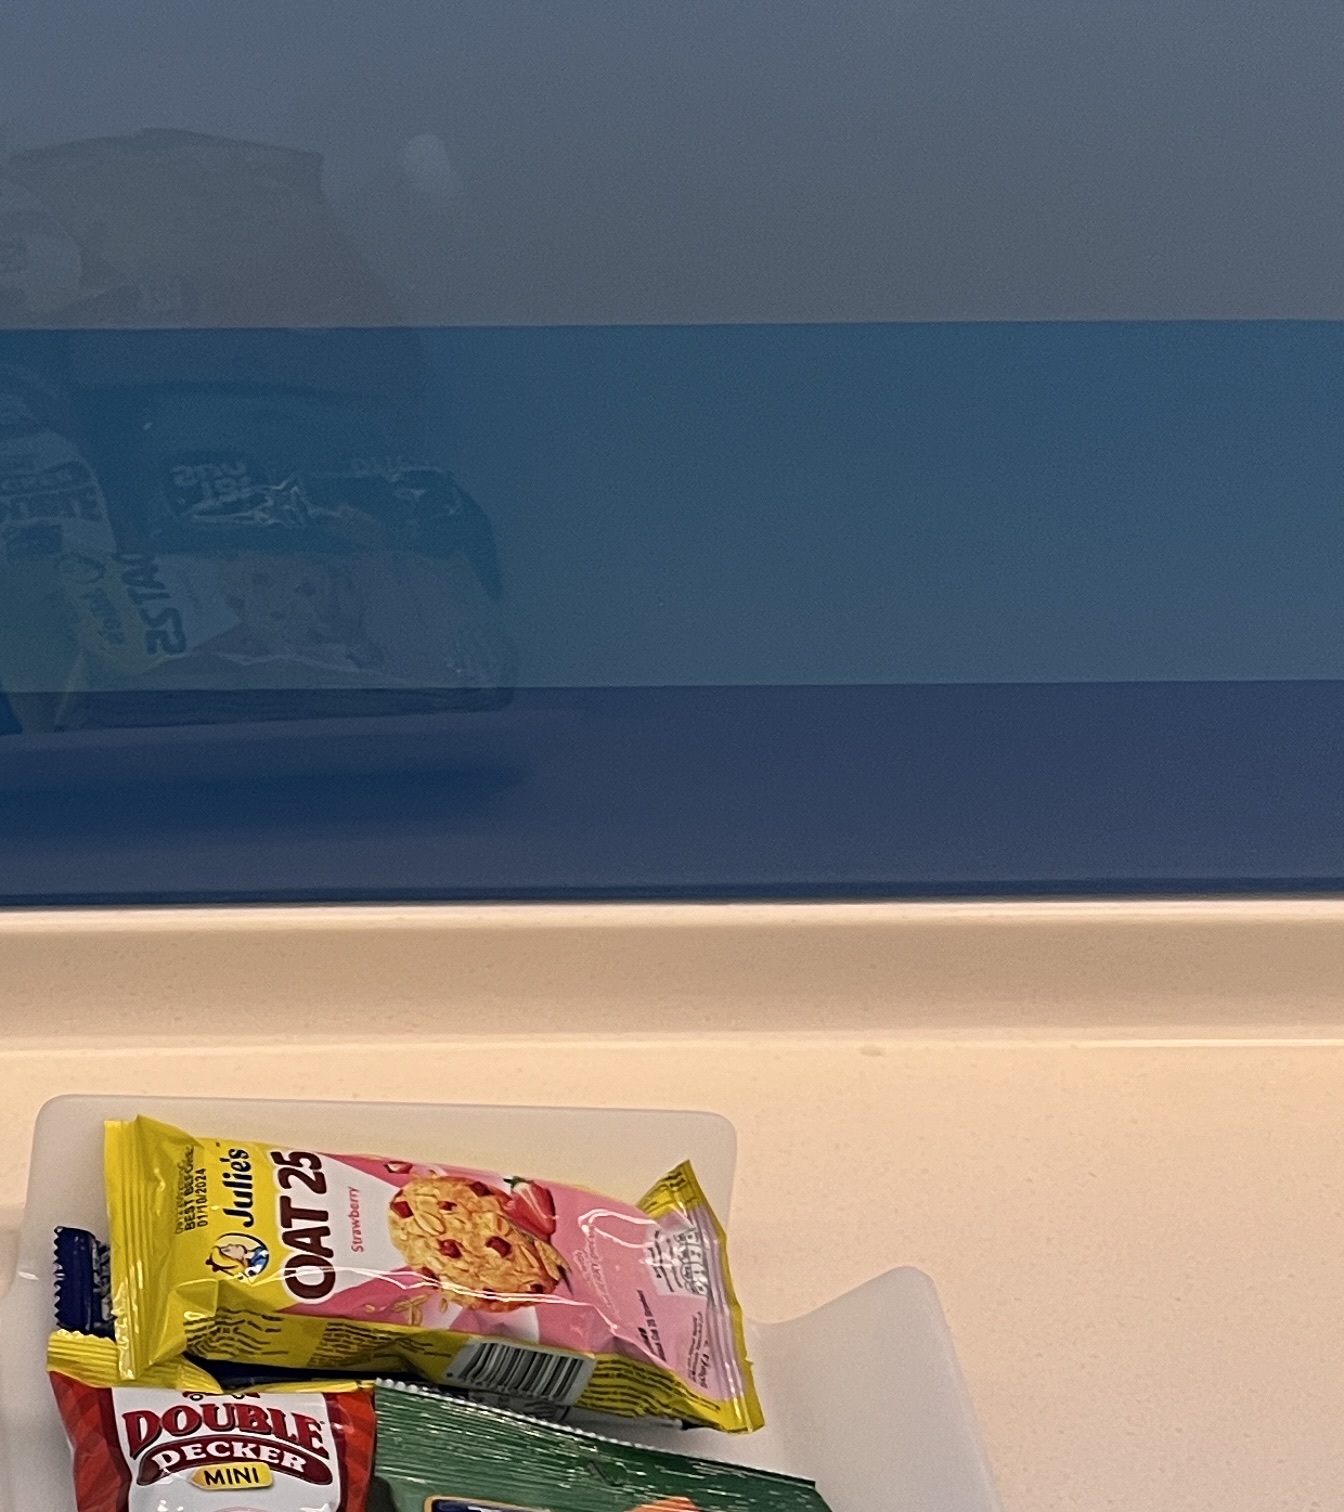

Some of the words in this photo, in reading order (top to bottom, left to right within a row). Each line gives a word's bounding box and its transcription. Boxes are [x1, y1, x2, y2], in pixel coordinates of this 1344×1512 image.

[220, 1148, 255, 1229] Julie's
[270, 1150, 329, 1196] 25
[278, 1194, 336, 1301] OAT
[347, 1186, 364, 1254] Strawberry
[122, 1402, 330, 1461] DOUBLE
[152, 1440, 307, 1473] DECKER
[204, 1467, 260, 1486] MINI
